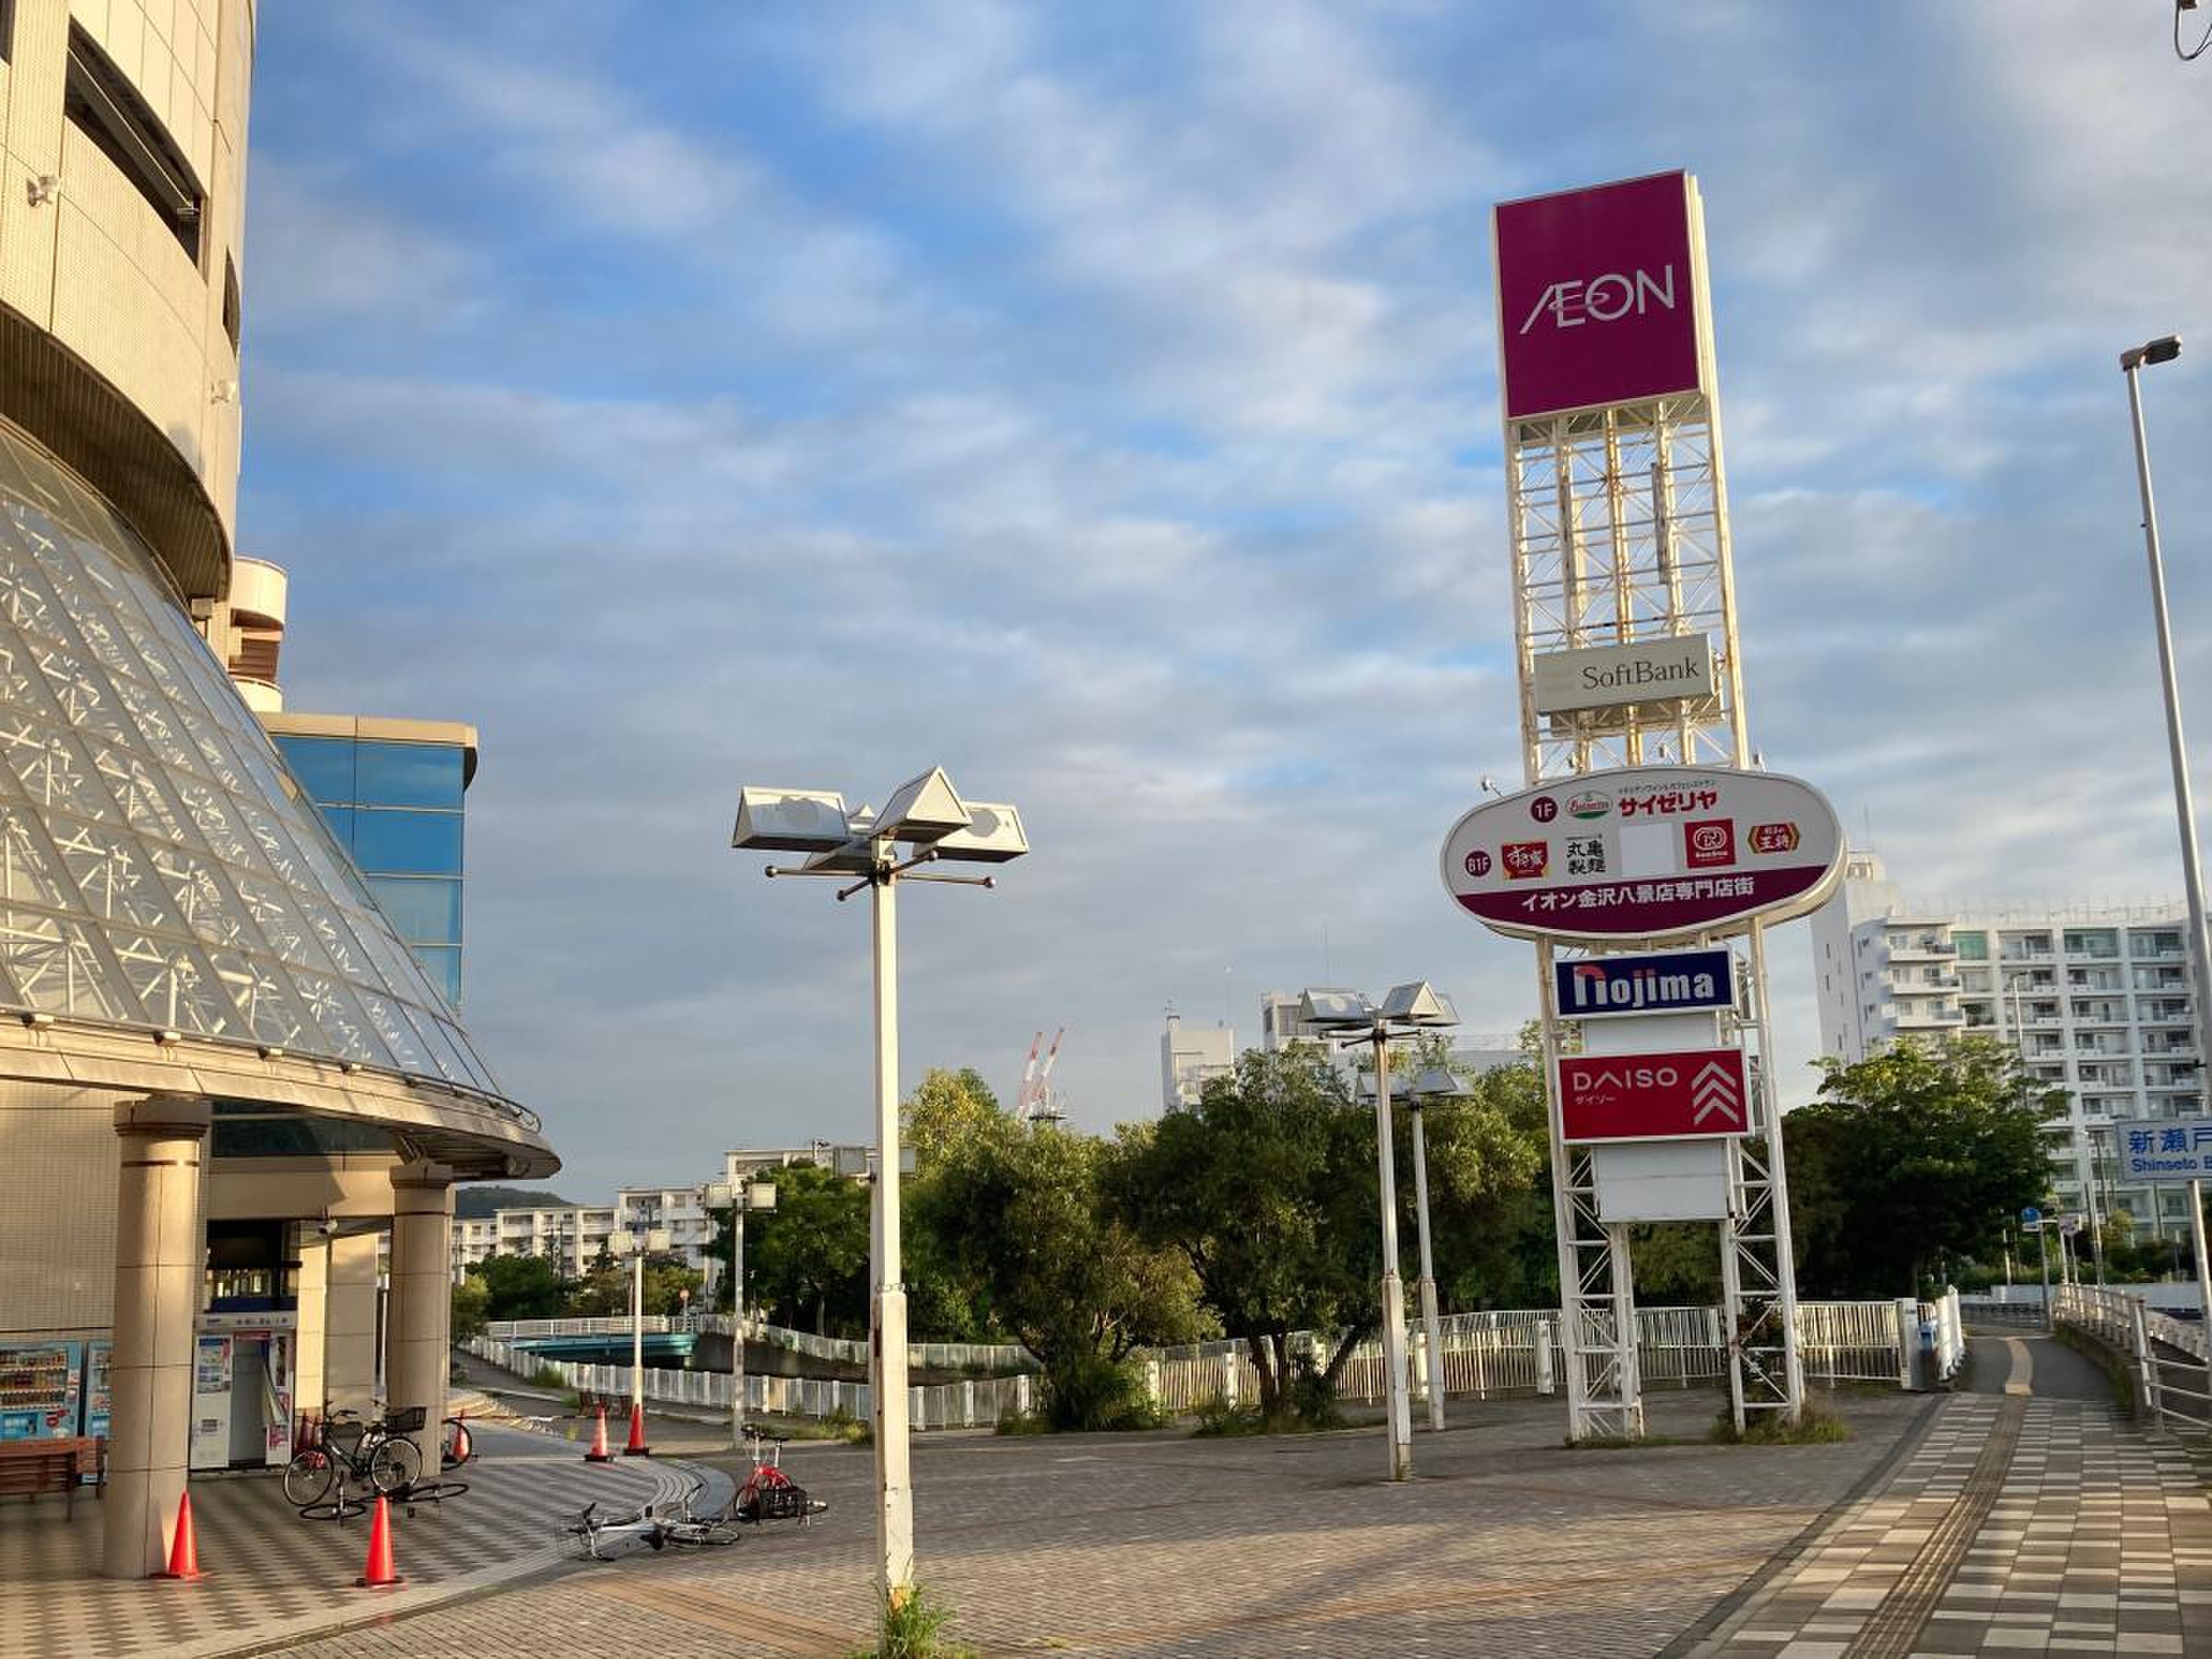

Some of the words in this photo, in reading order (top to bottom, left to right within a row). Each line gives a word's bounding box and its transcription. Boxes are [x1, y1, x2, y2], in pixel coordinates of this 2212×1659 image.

[1582, 656, 1700, 690] SoftBank
[1535, 802, 1554, 818] 1F
[1618, 791, 1718, 817] サイゼリヤ
[1466, 856, 1491, 873] B1F
[1521, 877, 1755, 912] イオン金沢八景店専門店街
[1571, 1067, 1678, 1091] DAISO
[1575, 1094, 1617, 1105] ダイソー
[2129, 1127, 2212, 1154] 新瀬戸
[2131, 1157, 2198, 1172] Shinseto
